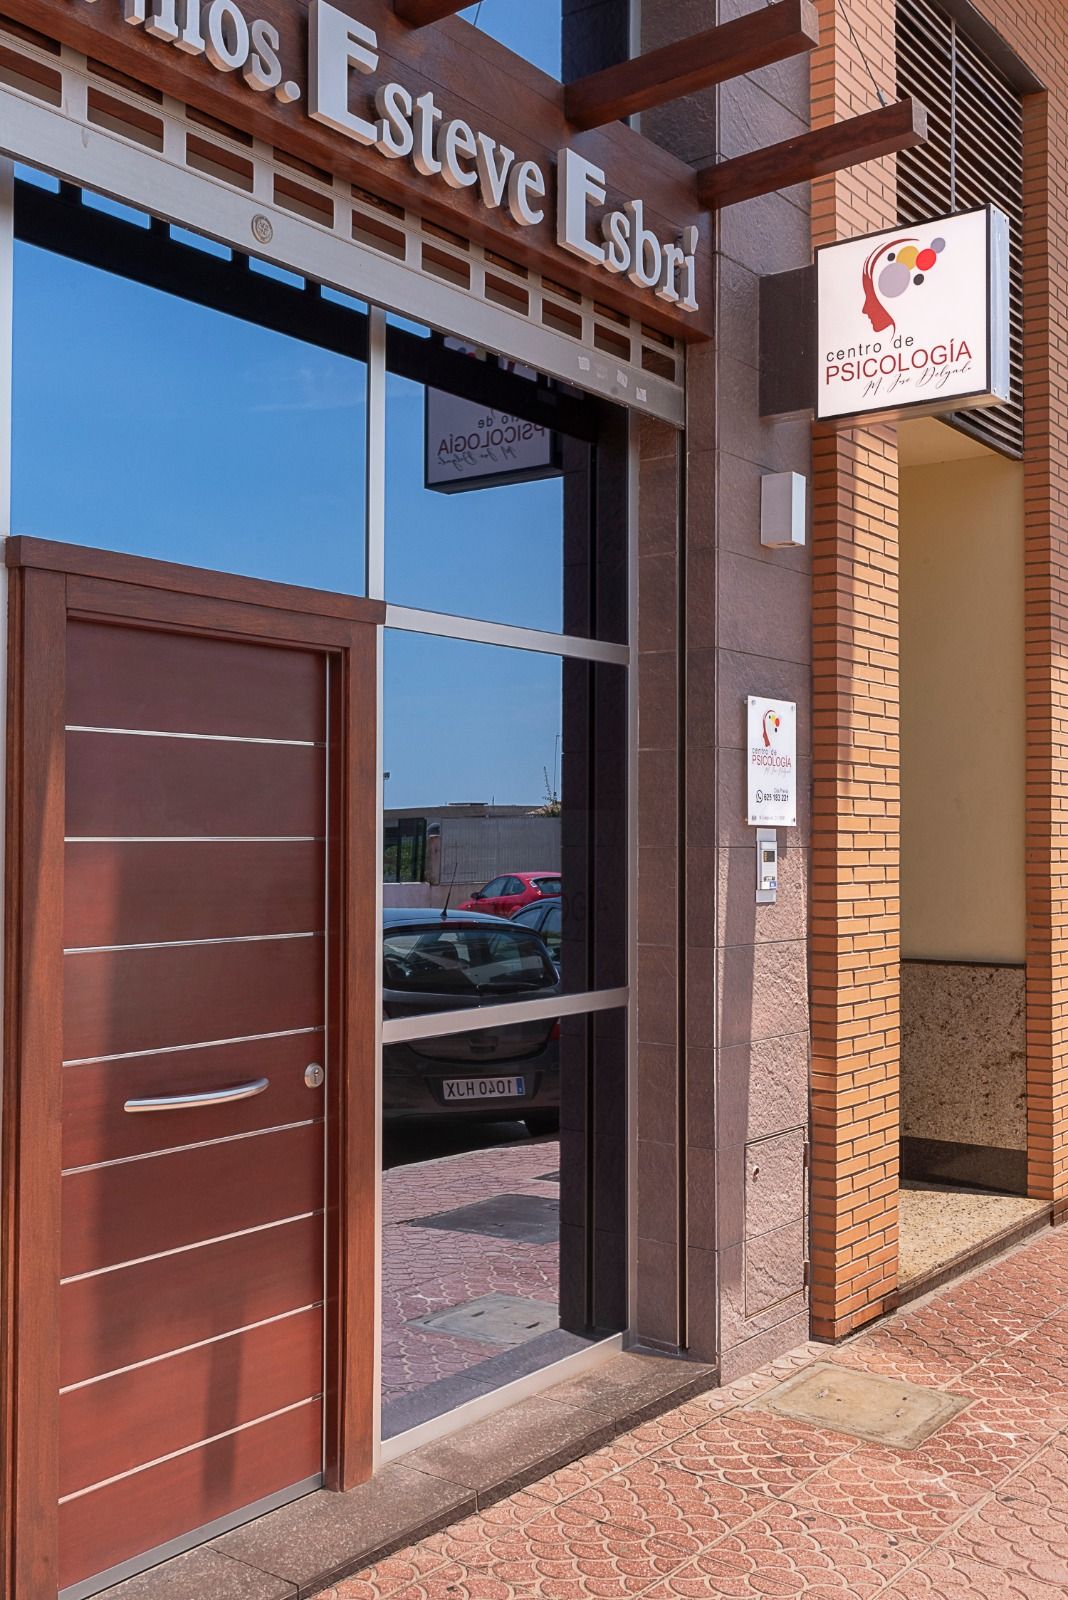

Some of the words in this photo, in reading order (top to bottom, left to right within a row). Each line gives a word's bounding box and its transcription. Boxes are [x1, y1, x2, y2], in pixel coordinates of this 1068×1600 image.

[308, 0, 546, 226] Esteve
[557, 147, 699, 312] Esbrí
[826, 342, 882, 362] centro
[893, 335, 914, 349] de
[826, 338, 972, 385] PSICOLOGÍA
[915, 360, 972, 389] Delgado
[752, 755, 792, 767] PSICOLOGÍA
